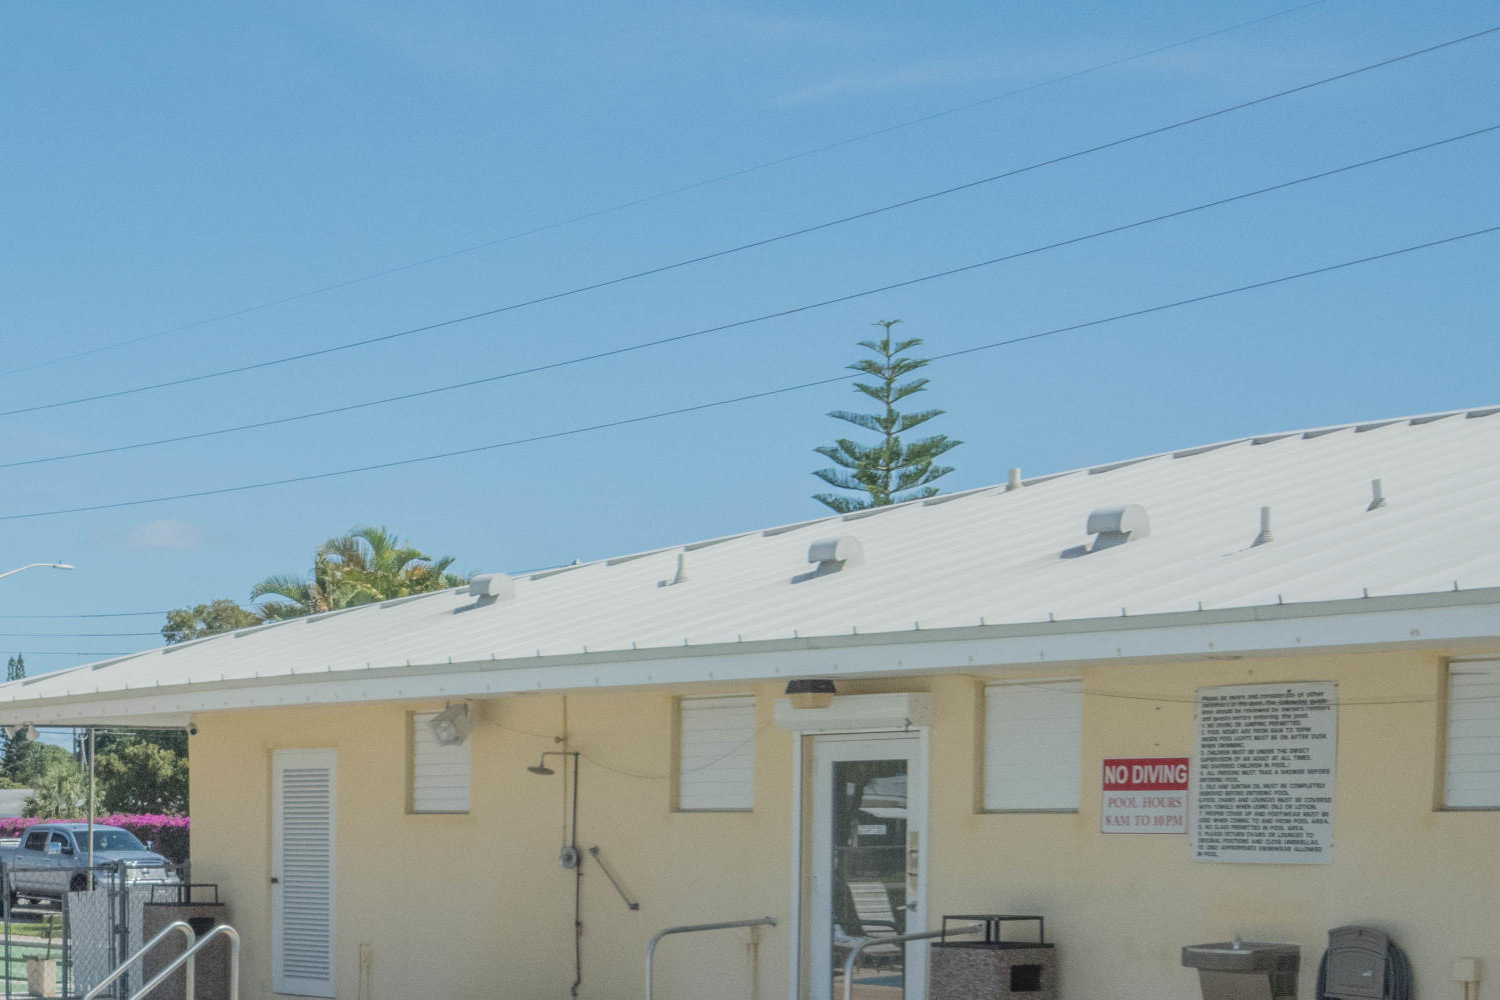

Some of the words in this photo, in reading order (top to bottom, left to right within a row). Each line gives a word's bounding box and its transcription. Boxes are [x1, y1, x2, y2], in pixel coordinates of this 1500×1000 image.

[1104, 765, 1129, 784] NO
[1131, 764, 1188, 784] DIVING
[1108, 797, 1137, 808] POOL
[1142, 796, 1182, 808] HOURS
[1134, 815, 1150, 826] TO
